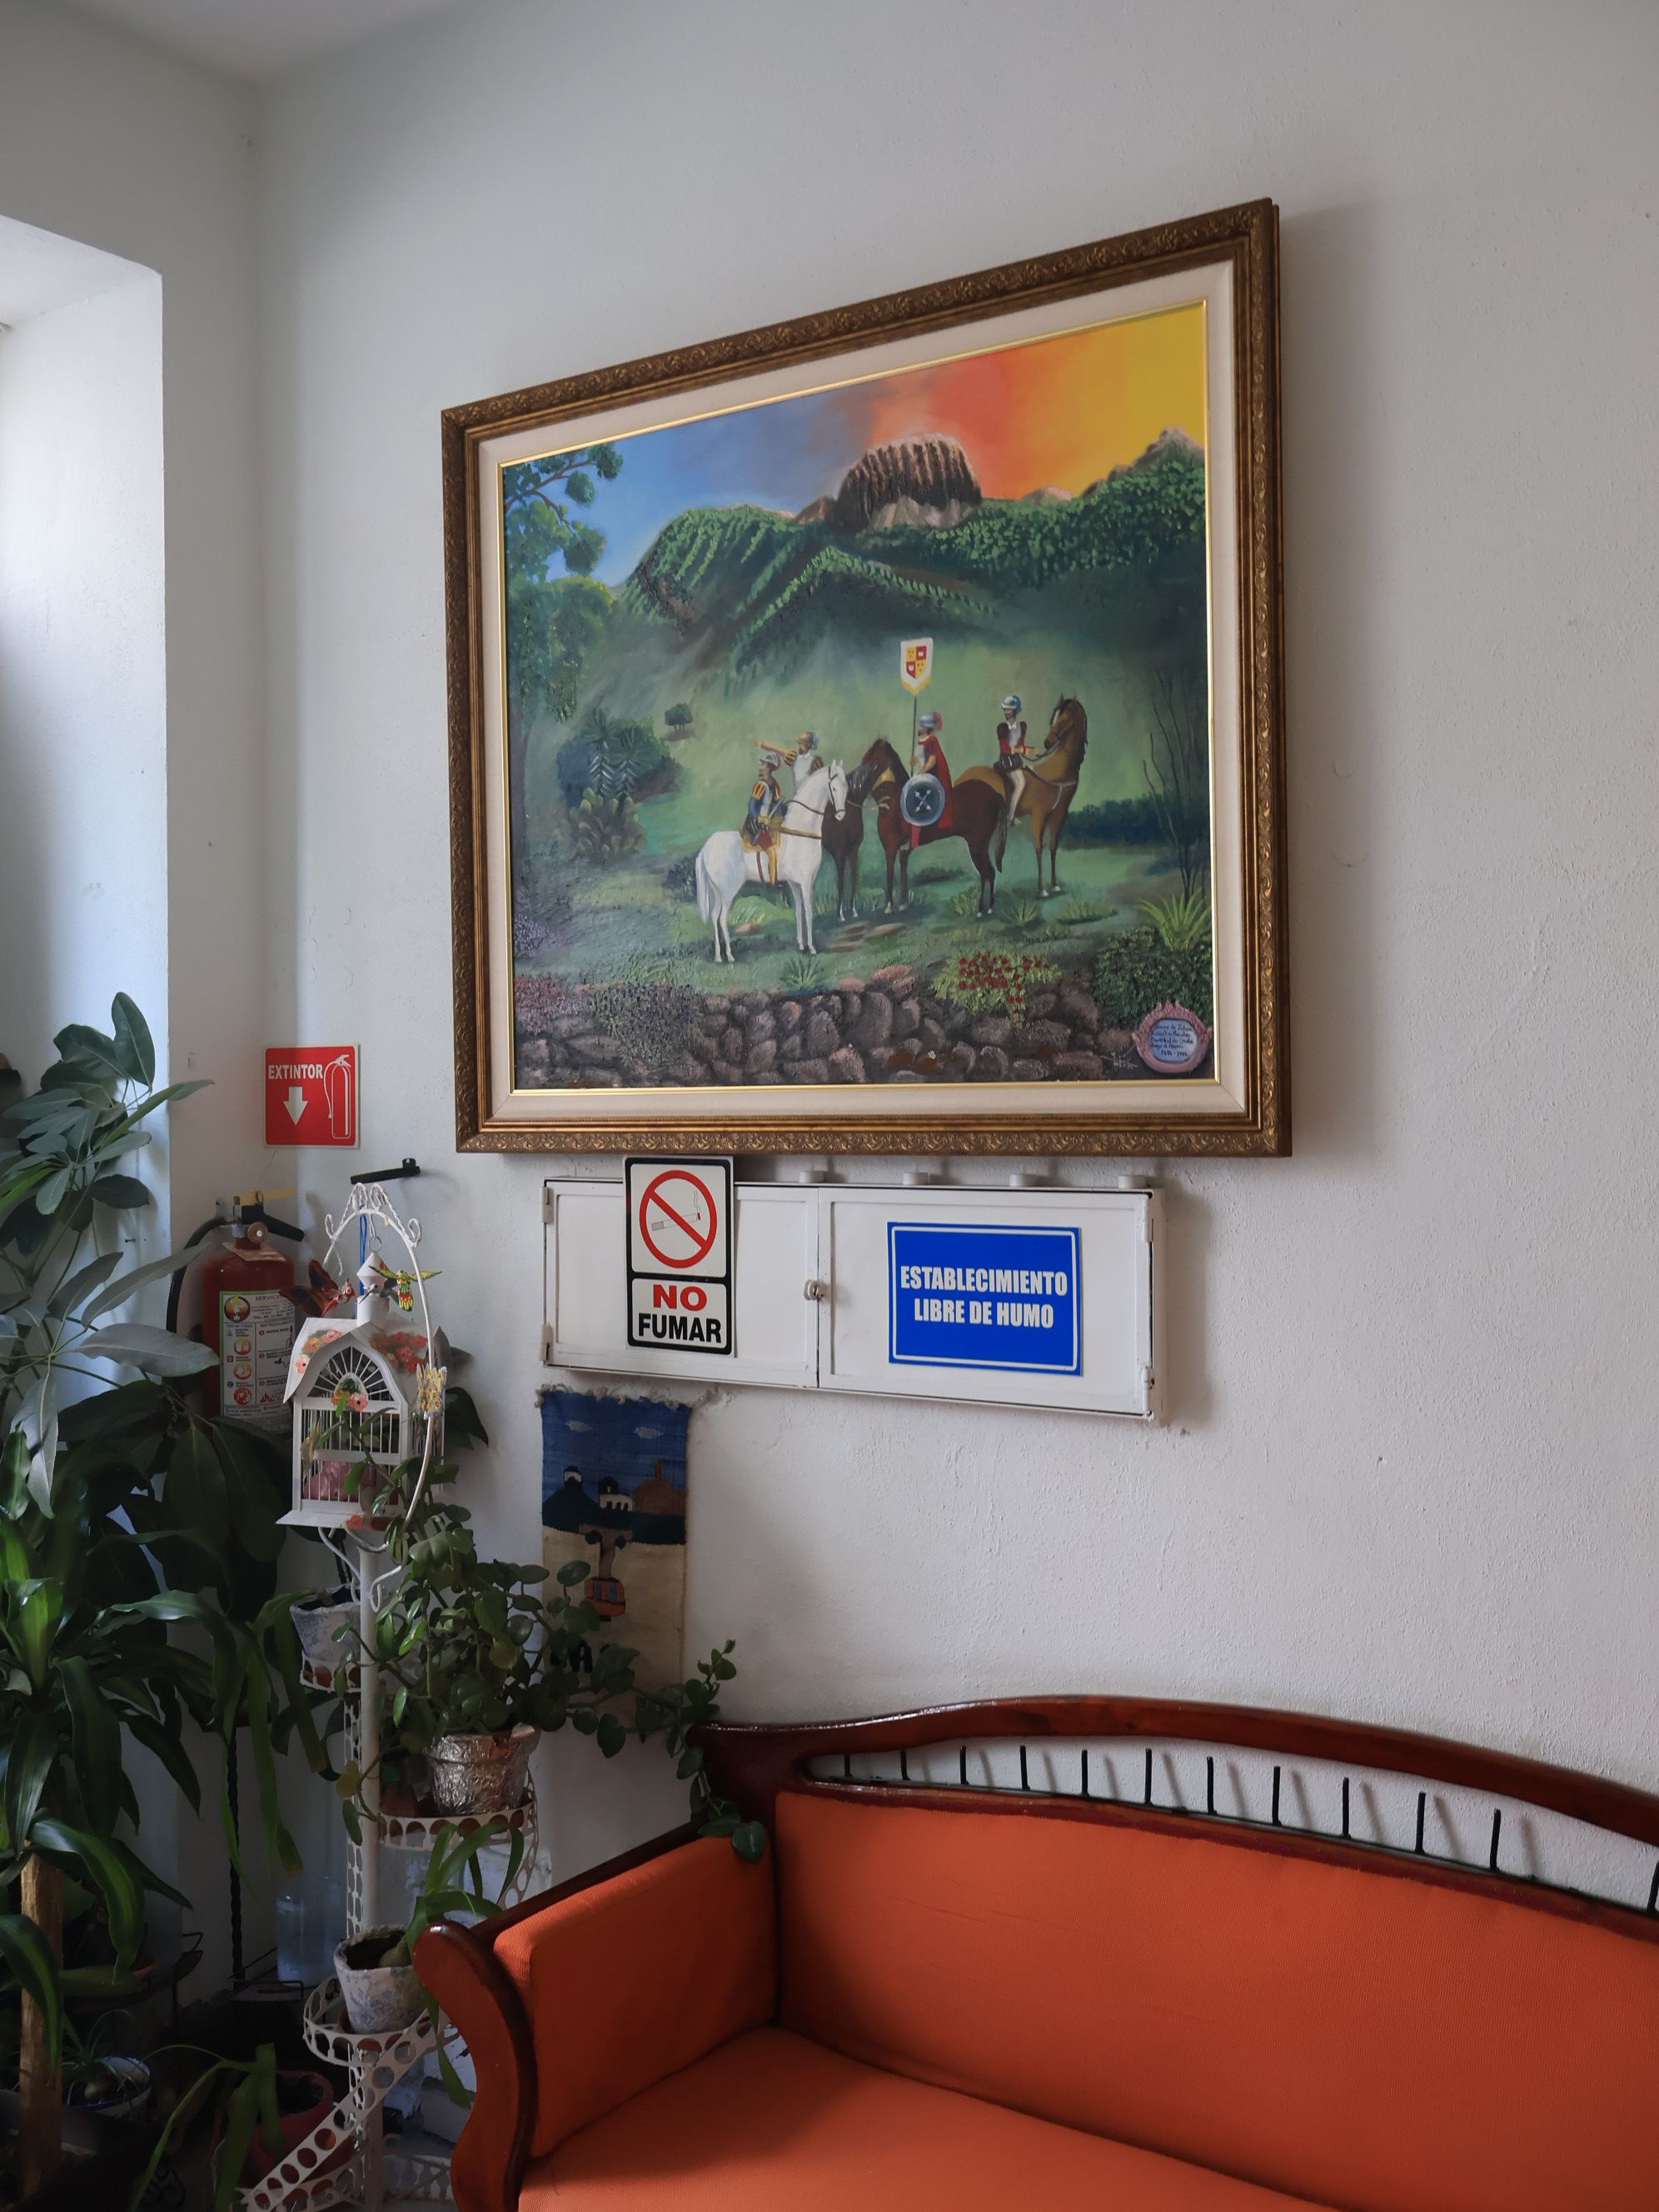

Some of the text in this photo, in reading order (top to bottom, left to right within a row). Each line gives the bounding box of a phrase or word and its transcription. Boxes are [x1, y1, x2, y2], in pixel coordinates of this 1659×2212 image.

[268, 1064, 323, 1079] EXTINTOR
[900, 1265, 1068, 1297] ESTABLECIMIENTO
[653, 1283, 707, 1311] NO
[638, 1313, 722, 1343] FUMAR
[914, 1298, 1054, 1328] LIBRE DE HUMO
